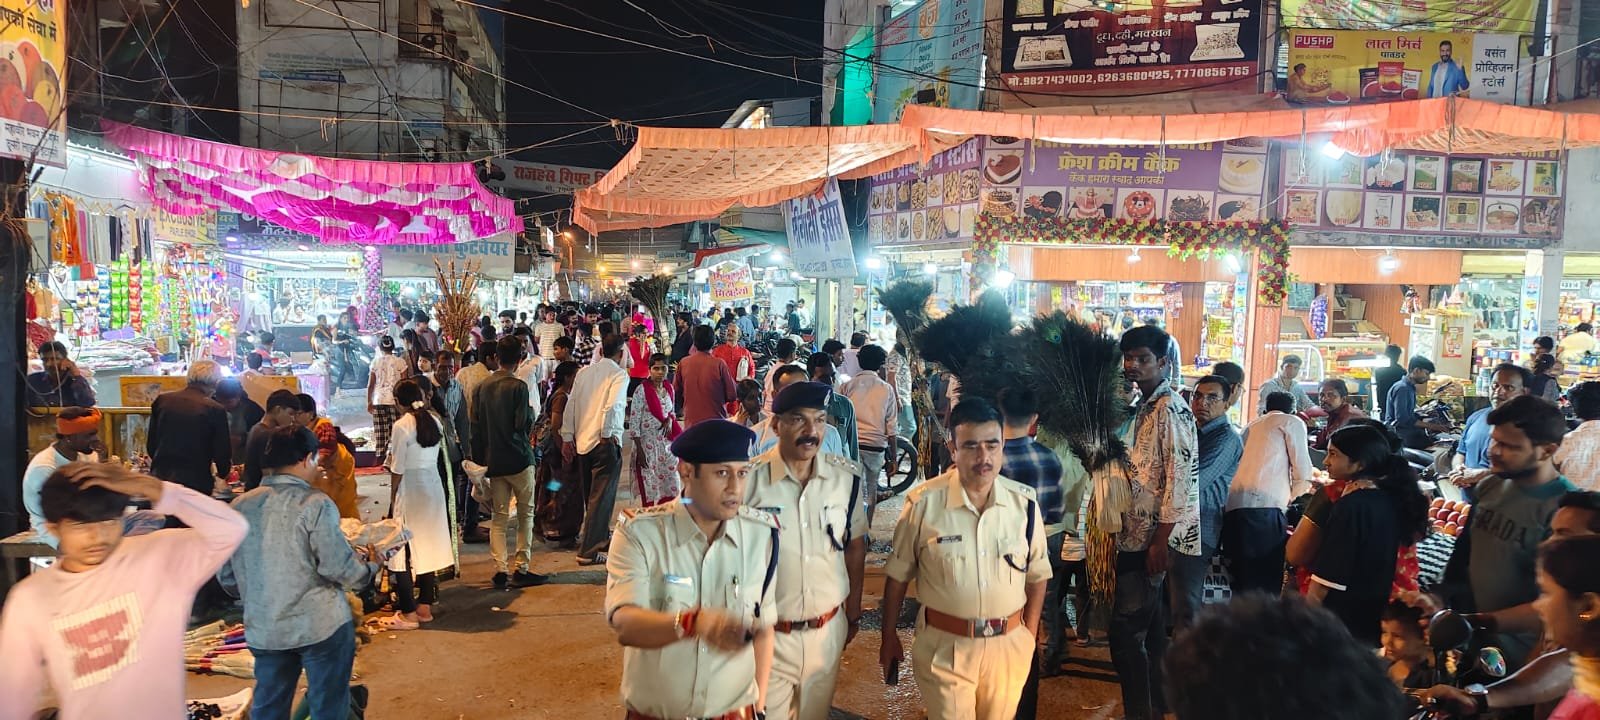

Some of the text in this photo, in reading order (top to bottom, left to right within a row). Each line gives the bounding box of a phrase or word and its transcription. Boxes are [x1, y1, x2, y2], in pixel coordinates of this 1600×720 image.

[27, 12, 46, 37] सेवा
[49, 21, 57, 41] में
[1296, 37, 1332, 45] PUSHP
[1365, 36, 1423, 50] लाल मिर्च
[513, 164, 556, 182] राजहंस
[559, 168, 590, 186] गिफ्ट
